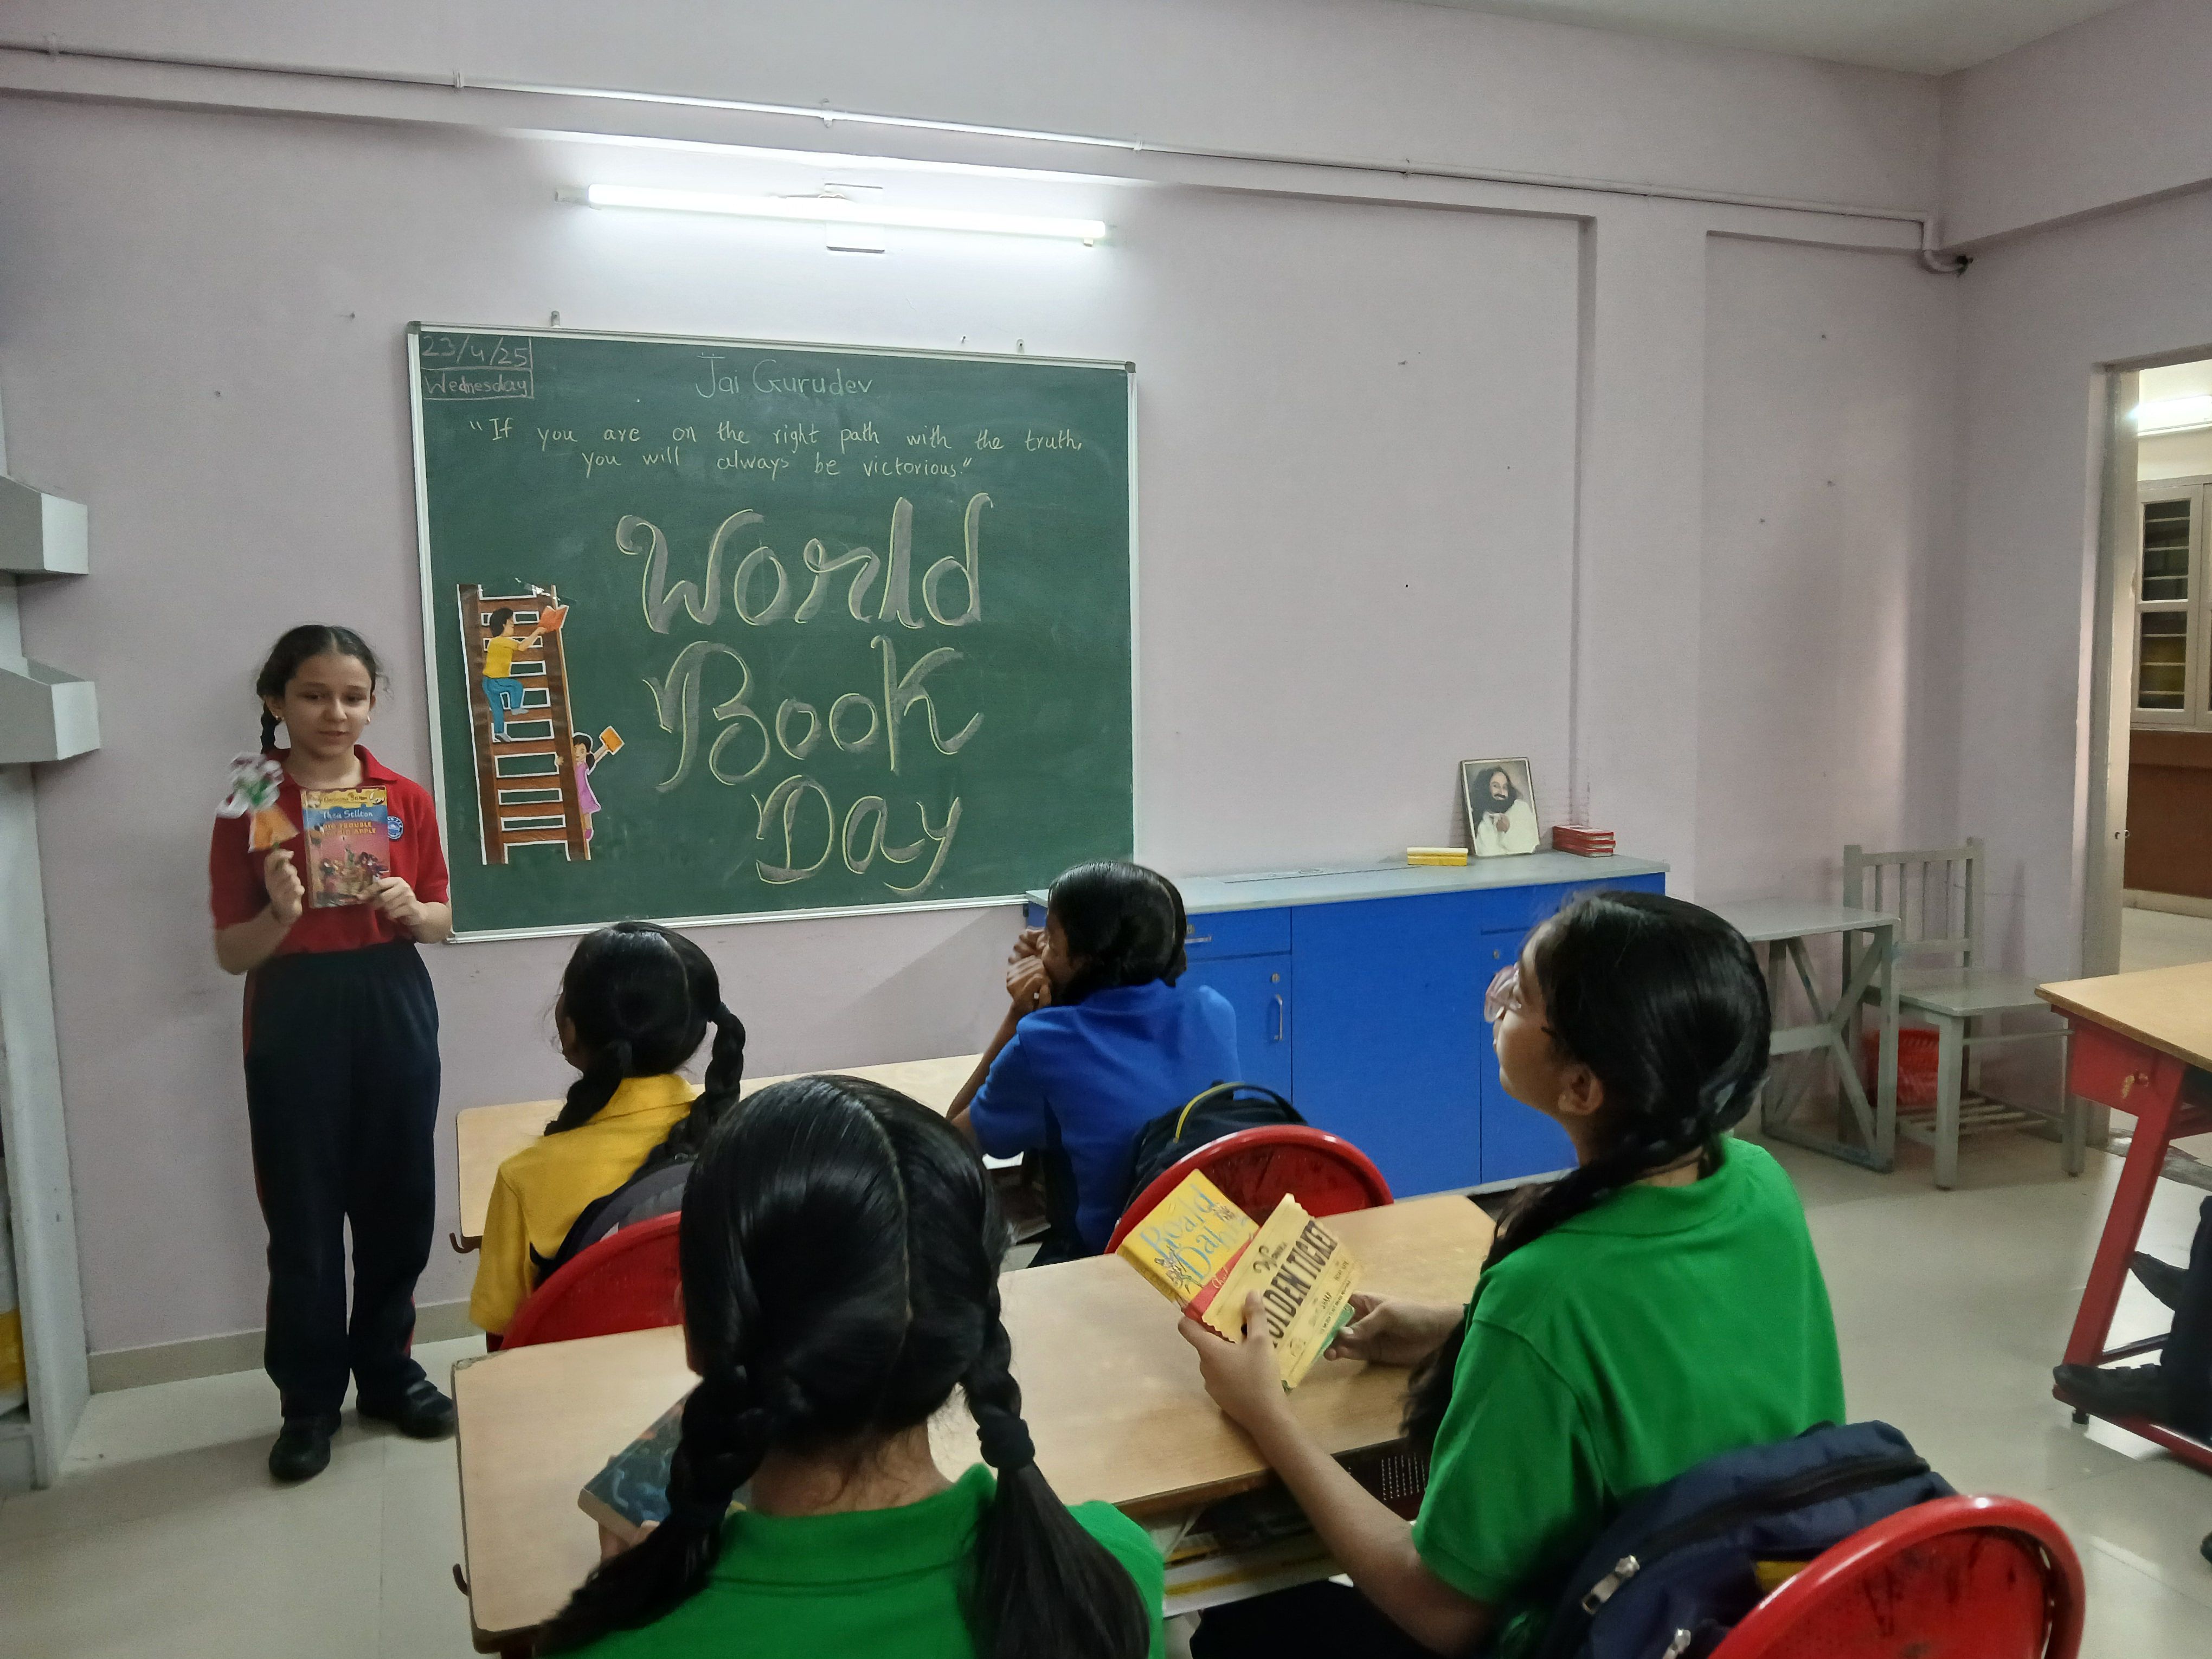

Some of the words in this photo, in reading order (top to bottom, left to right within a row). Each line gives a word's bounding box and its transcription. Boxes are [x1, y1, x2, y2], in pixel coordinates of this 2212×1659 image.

[422, 335, 528, 367] 23/4/25
[696, 353, 739, 398] Jai
[753, 359, 872, 396] Gurudev
[425, 372, 528, 397] Wednesday
[537, 426, 577, 452] you
[603, 427, 641, 442] are
[673, 426, 697, 442] on
[716, 421, 750, 443] the
[773, 423, 820, 454] right
[840, 421, 880, 454] path
[906, 425, 952, 449] with
[974, 429, 1005, 449] the
[582, 453, 621, 479] you
[642, 447, 679, 466] will
[717, 449, 789, 481] always
[814, 452, 840, 475] be
[616, 492, 993, 634] World
[642, 634, 985, 792] Book
[750, 775, 963, 897] Day
[1140, 1183, 1215, 1261] Roald
[1286, 1220, 1338, 1279] TICKET
[1263, 1263, 1312, 1349] OLDEN
